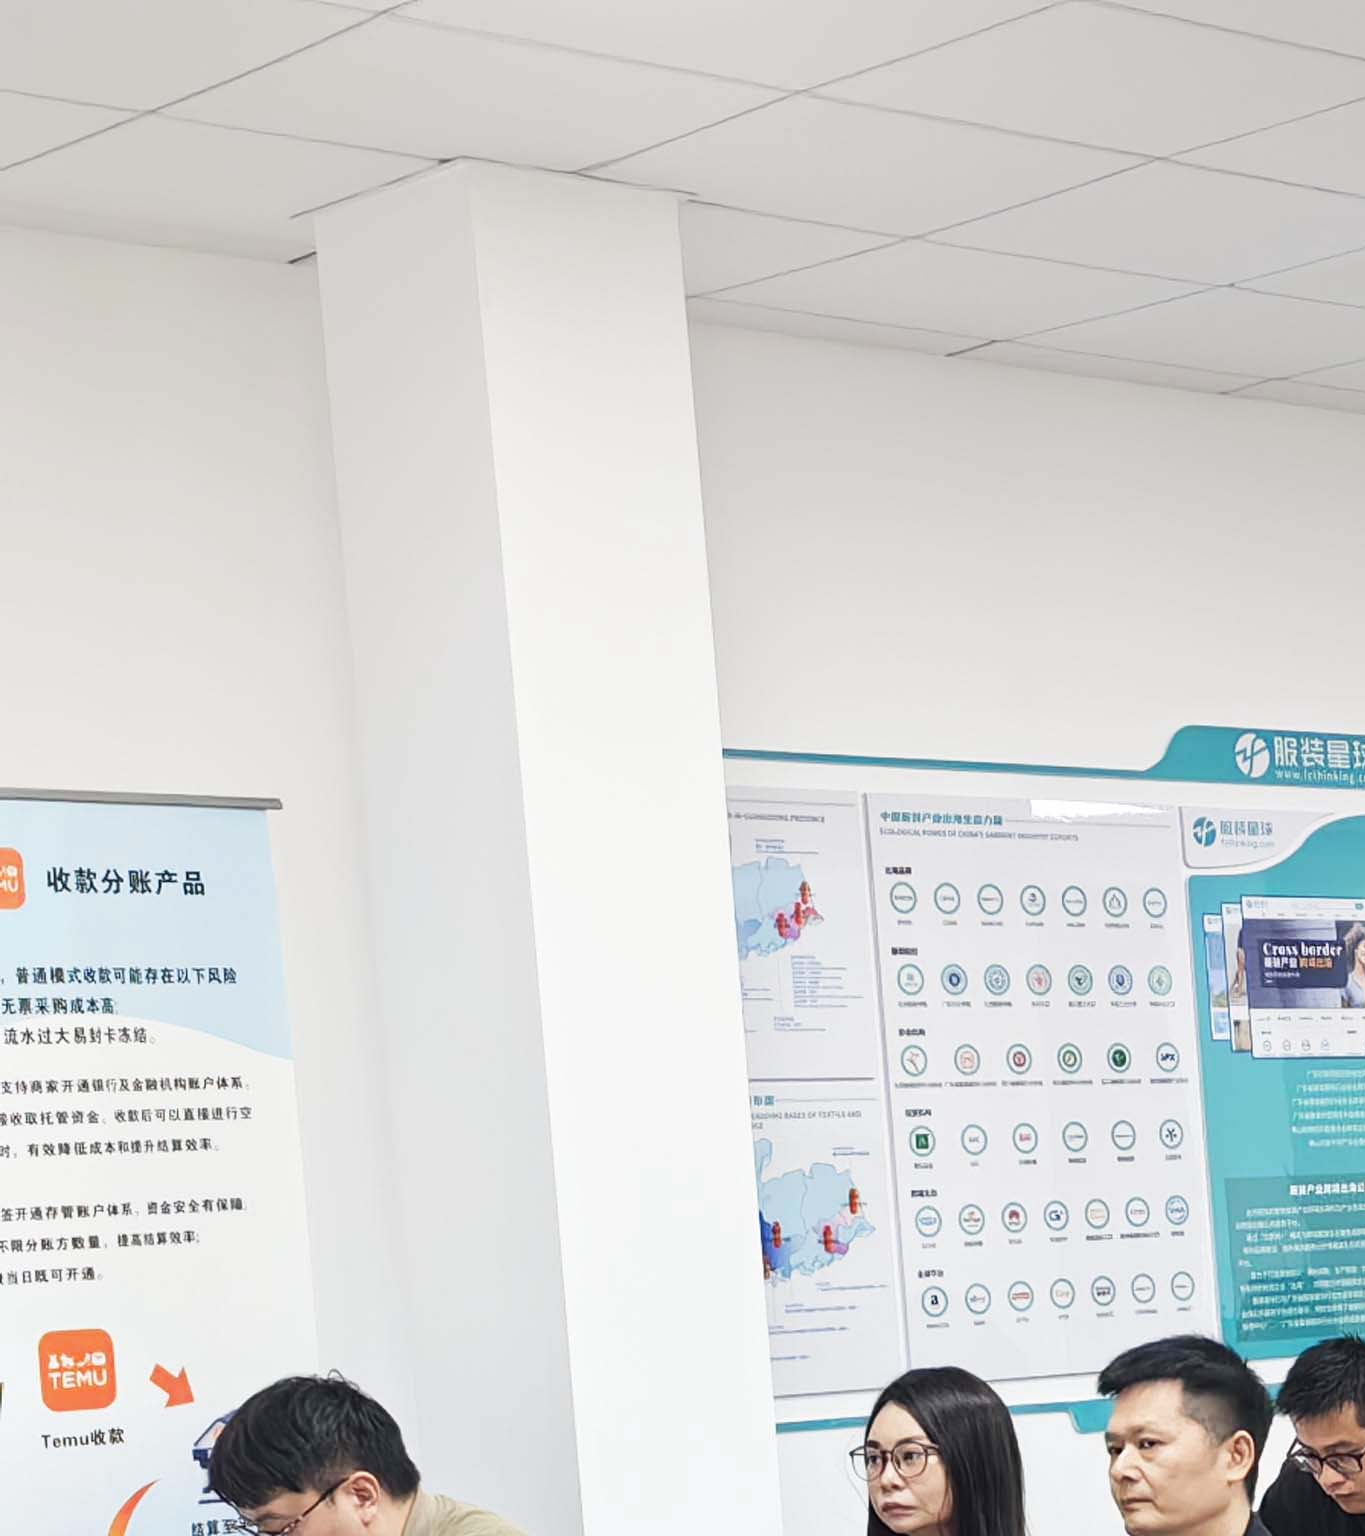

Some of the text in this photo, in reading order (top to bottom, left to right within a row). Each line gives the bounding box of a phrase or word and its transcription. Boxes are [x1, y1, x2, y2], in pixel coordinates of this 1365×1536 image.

[47, 867, 206, 897] 收款分账产品
[48, 1368, 108, 1390] TEMU
[41, 1427, 125, 1450] Temu收款
